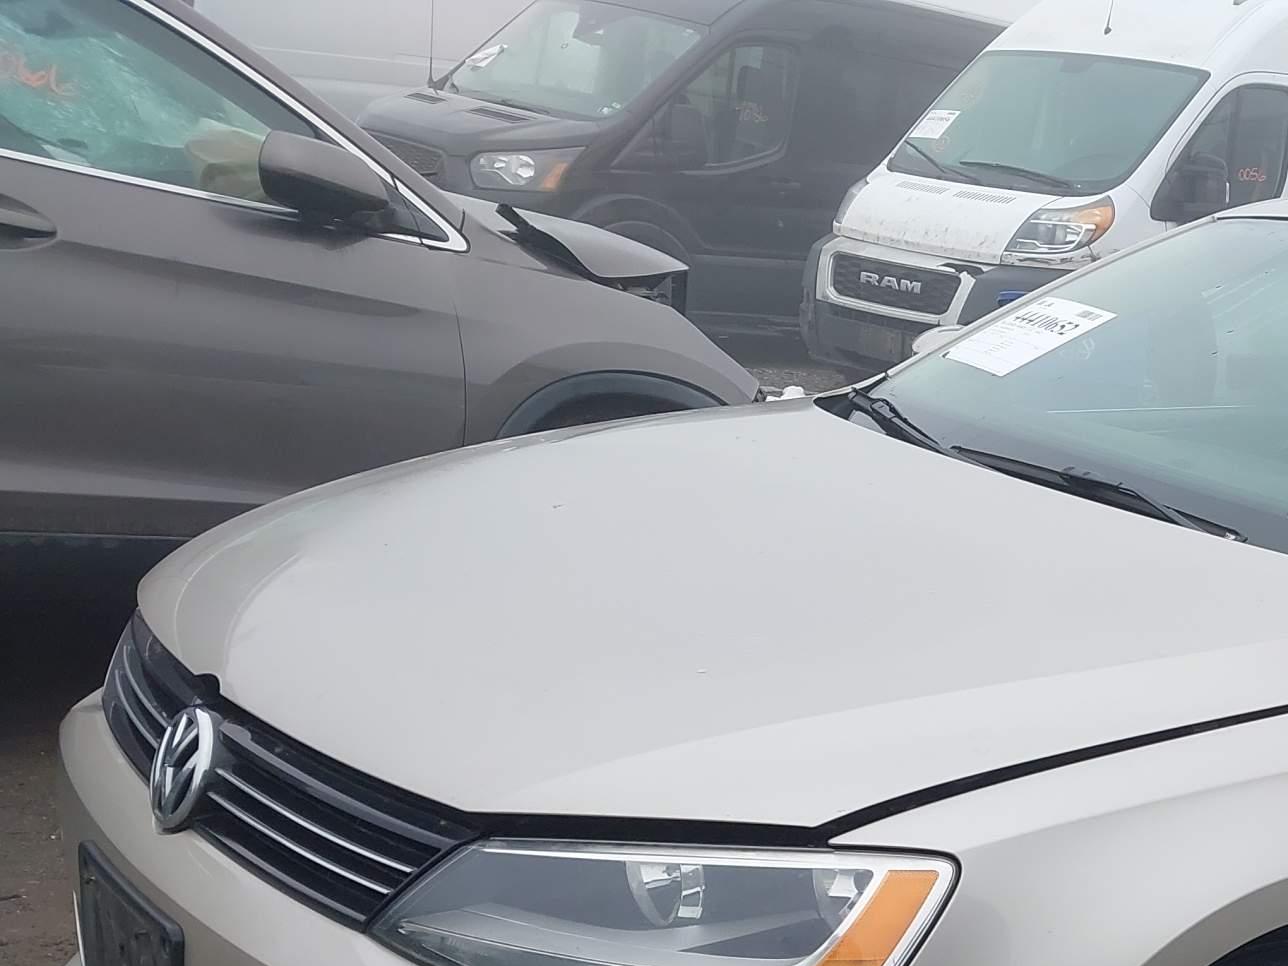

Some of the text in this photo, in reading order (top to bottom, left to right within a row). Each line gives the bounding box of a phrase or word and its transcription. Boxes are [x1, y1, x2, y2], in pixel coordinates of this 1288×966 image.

[1239, 167, 1266, 182] 0056
[860, 271, 922, 295] RAM
[1013, 311, 1081, 336] 44410652
